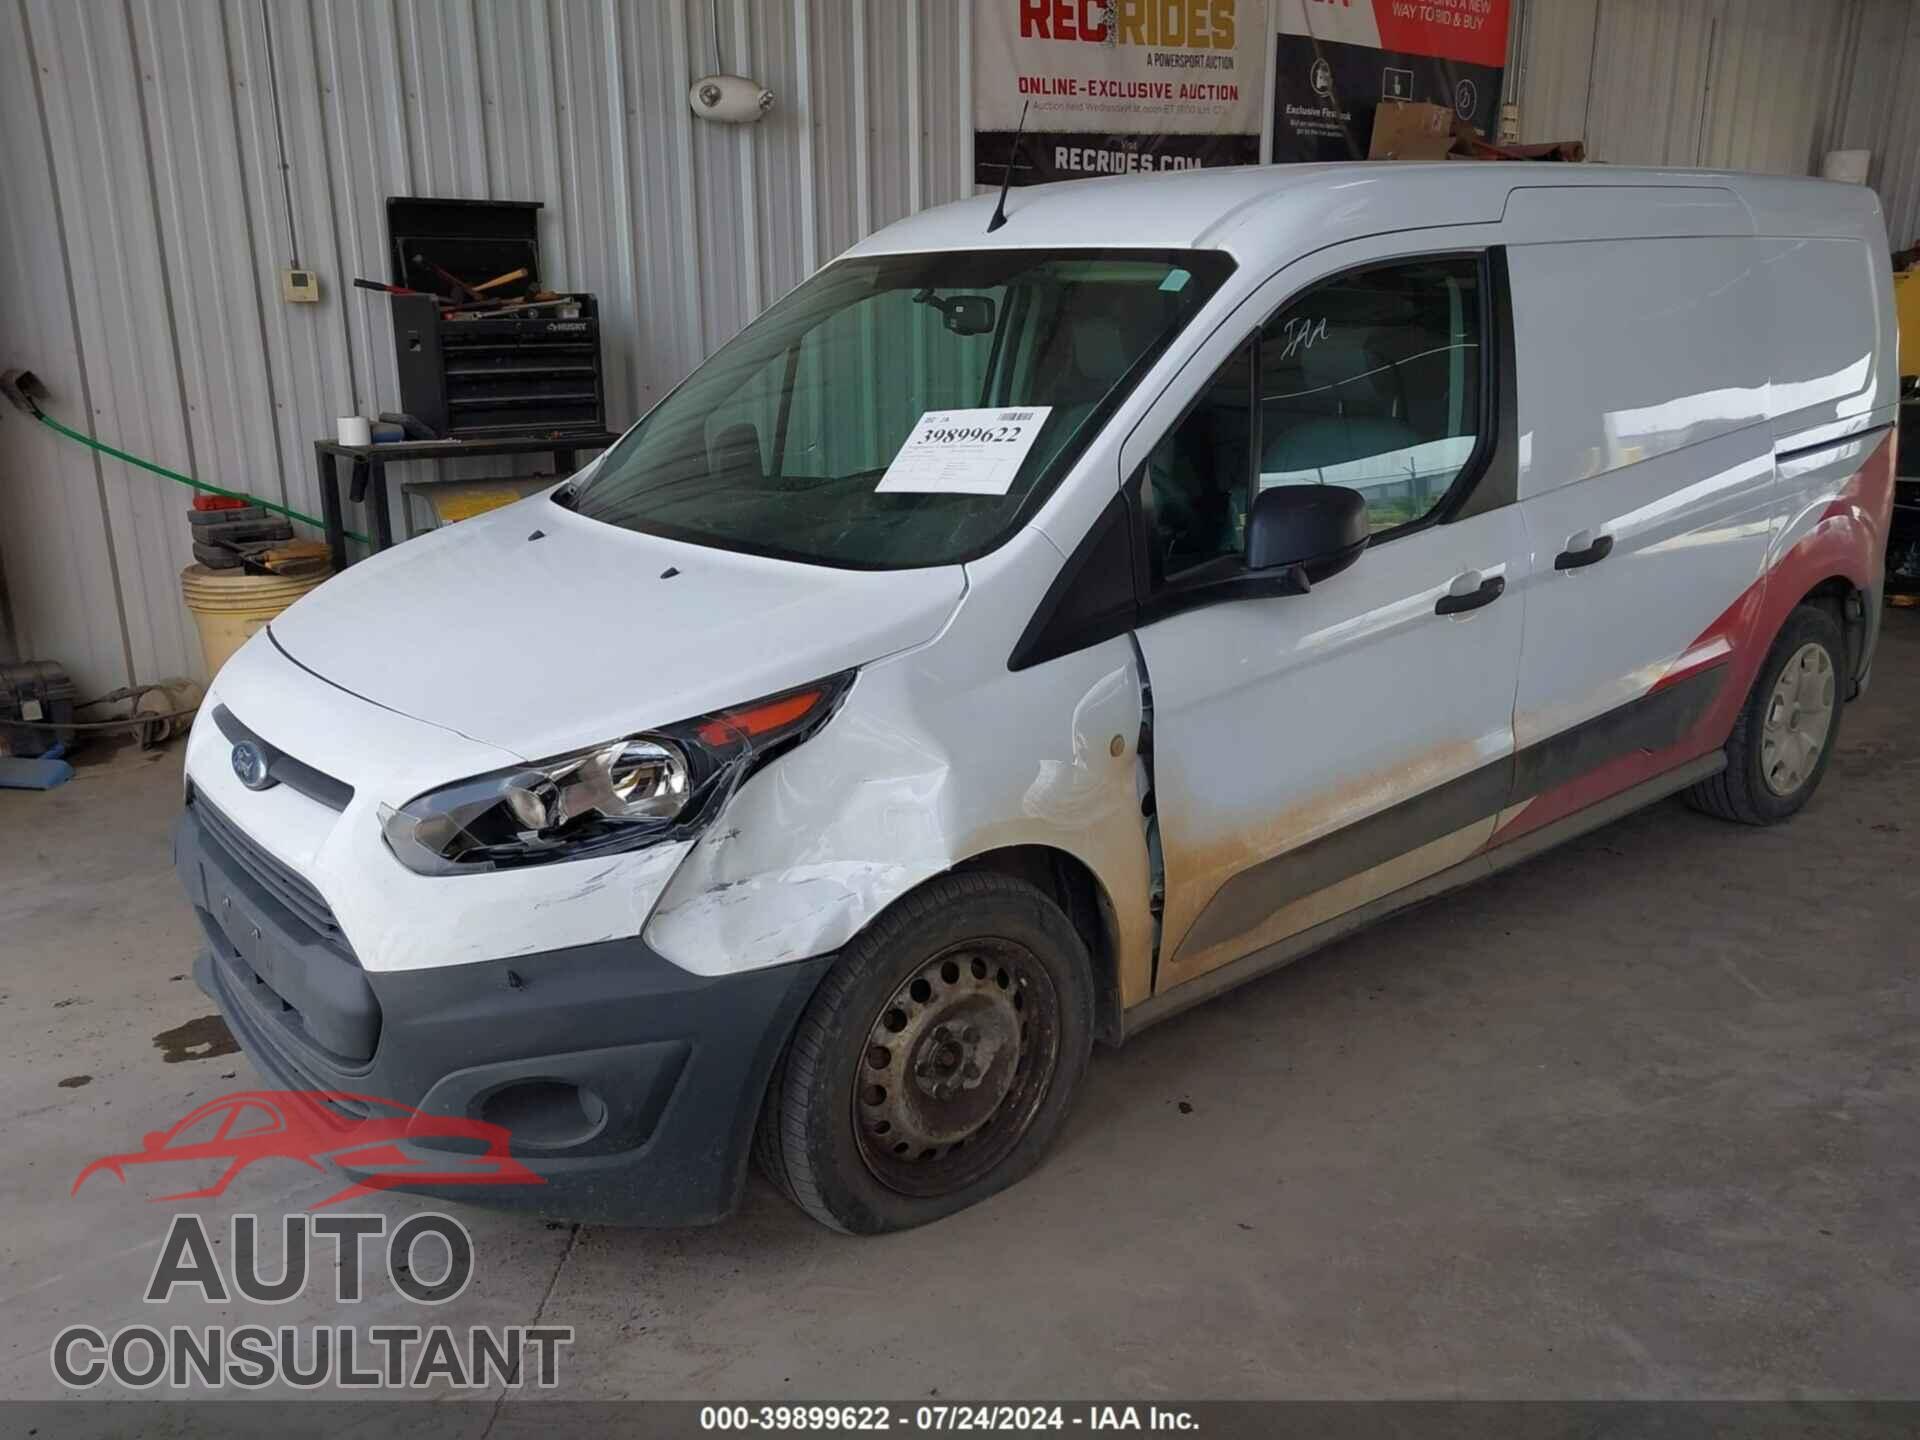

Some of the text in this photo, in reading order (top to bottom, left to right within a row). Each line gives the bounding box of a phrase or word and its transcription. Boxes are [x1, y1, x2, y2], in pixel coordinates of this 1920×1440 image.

[1392, 3, 1417, 19] WAY
[1420, 6, 1434, 22] TO
[1463, 14, 1484, 29] BUY
[1154, 53, 1204, 68] POWERSPORT
[1205, 55, 1234, 70] AUCTION
[1018, 77, 1239, 101] ONLINE-EXCLUSIVE AUCTION
[1055, 146, 1201, 174] RECRIDES.COM
[916, 427, 1022, 444] 39899622
